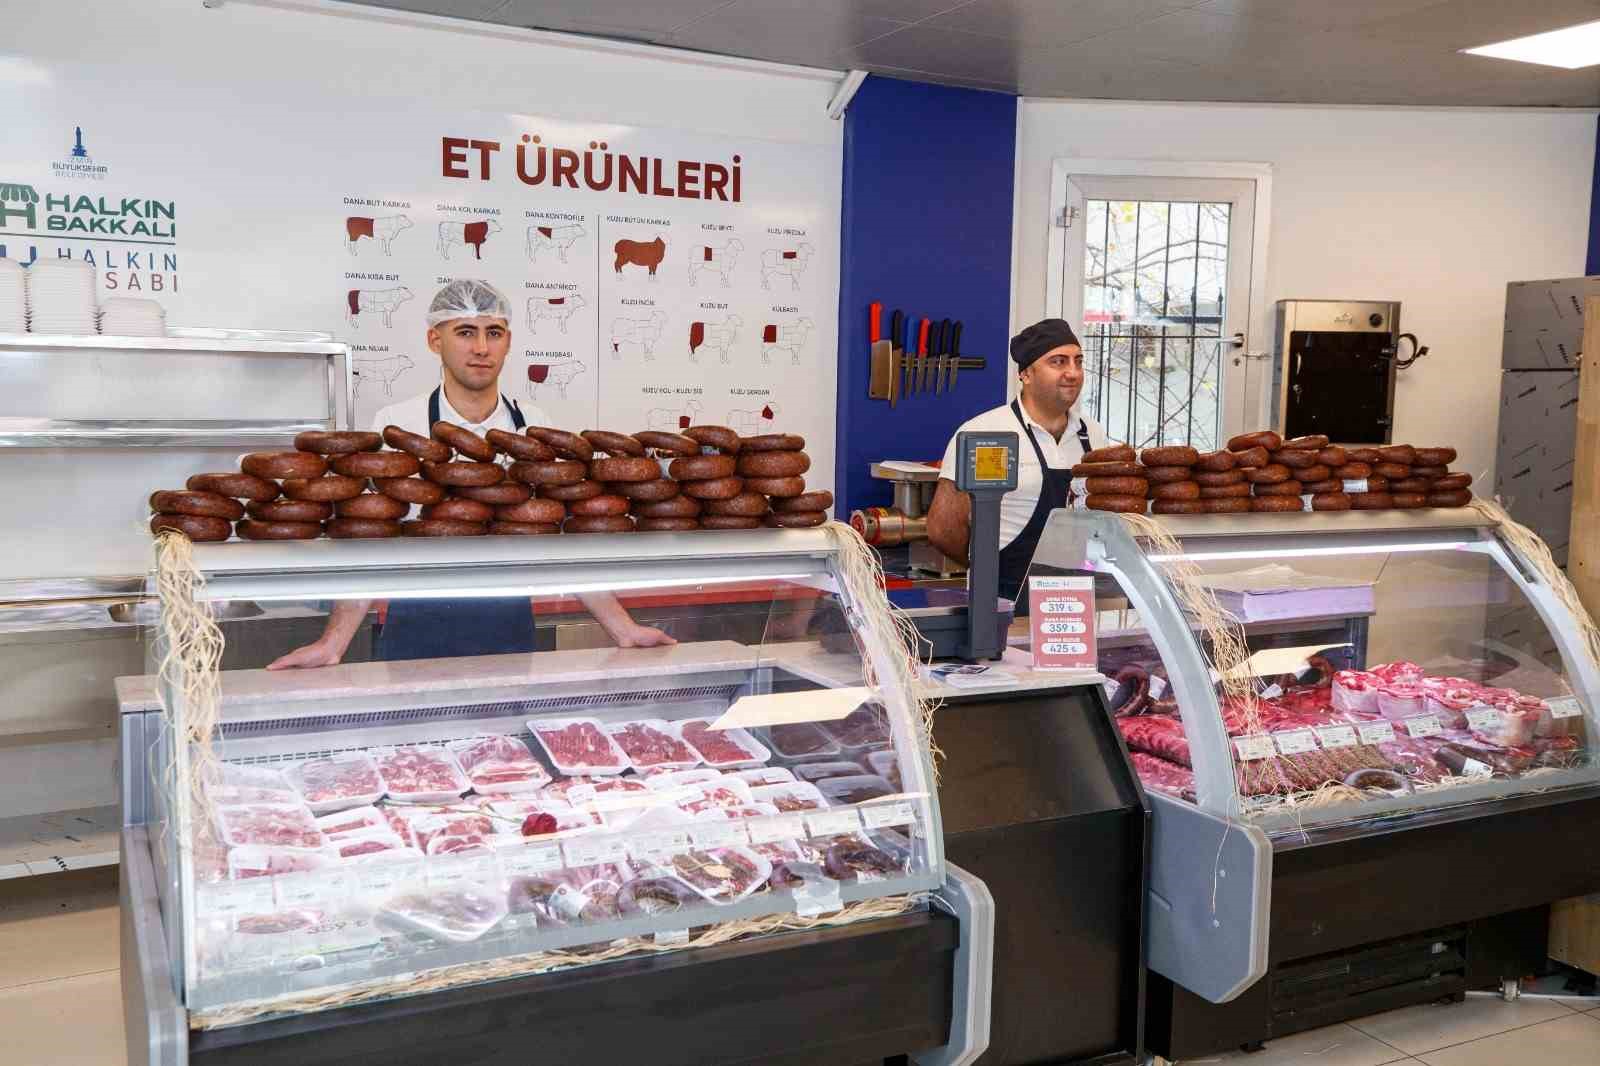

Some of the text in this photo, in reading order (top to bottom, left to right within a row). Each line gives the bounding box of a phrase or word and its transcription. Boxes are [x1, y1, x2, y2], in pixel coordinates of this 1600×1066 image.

[442, 134, 741, 202] ET ÜRÜNLERİ
[46, 193, 175, 219] HALKIN
[344, 196, 365, 206] DANA
[366, 198, 381, 207] BUT
[473, 207, 501, 216] KARKAS
[525, 210, 544, 219] DANA
[47, 215, 176, 238] BAKKALI
[57, 247, 177, 271] HALKIN
[345, 271, 366, 280] DANA
[385, 273, 399, 282] BUT
[105, 272, 178, 293] SABI
[525, 281, 544, 290] DANA
[351, 343, 368, 352] ANA
[525, 350, 544, 358] DANA
[1048, 603, 1065, 612] 319
[1048, 623, 1068, 633] 359
[1050, 644, 1069, 654] 425
